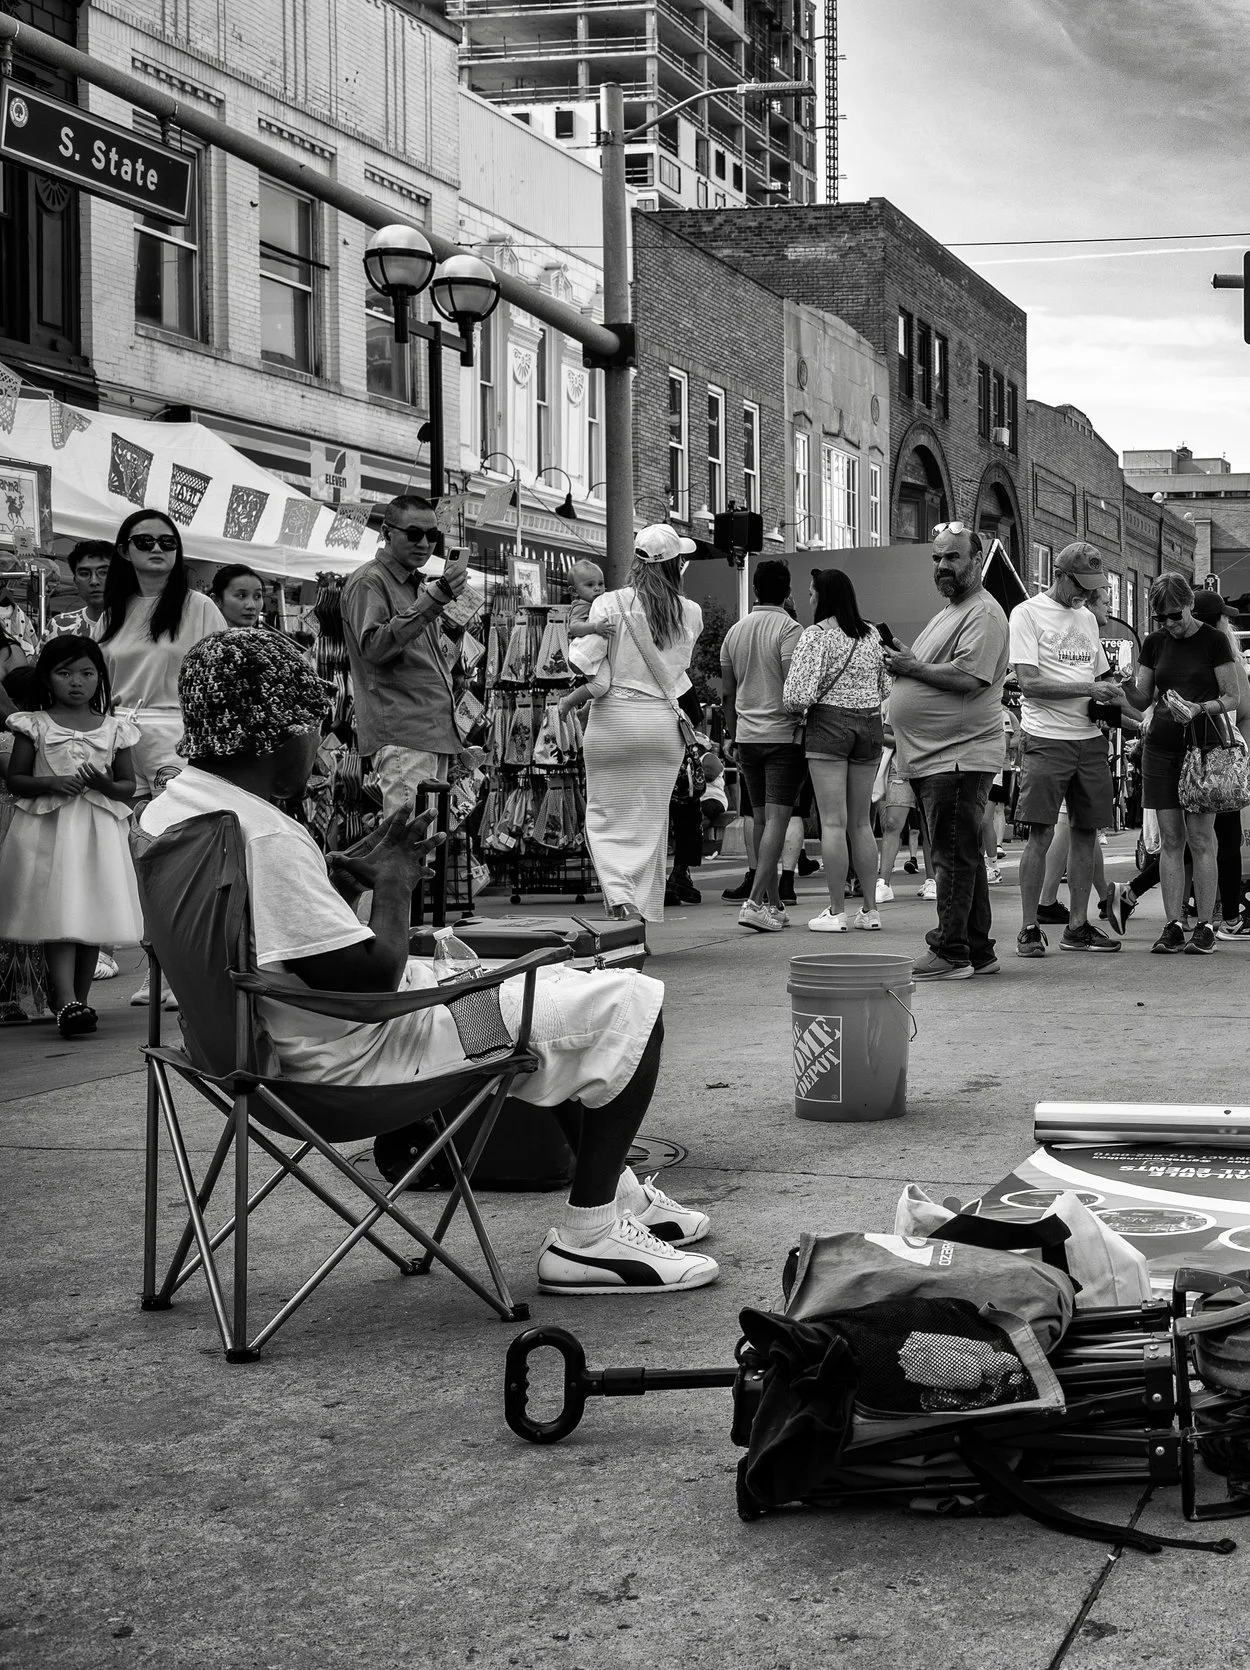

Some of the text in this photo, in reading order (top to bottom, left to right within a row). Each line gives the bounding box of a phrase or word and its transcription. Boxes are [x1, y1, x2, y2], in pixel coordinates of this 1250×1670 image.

[59, 126, 158, 190] S. State
[798, 1048, 841, 1098] DEPOT
[1119, 1165, 1212, 1174] EVENTS
